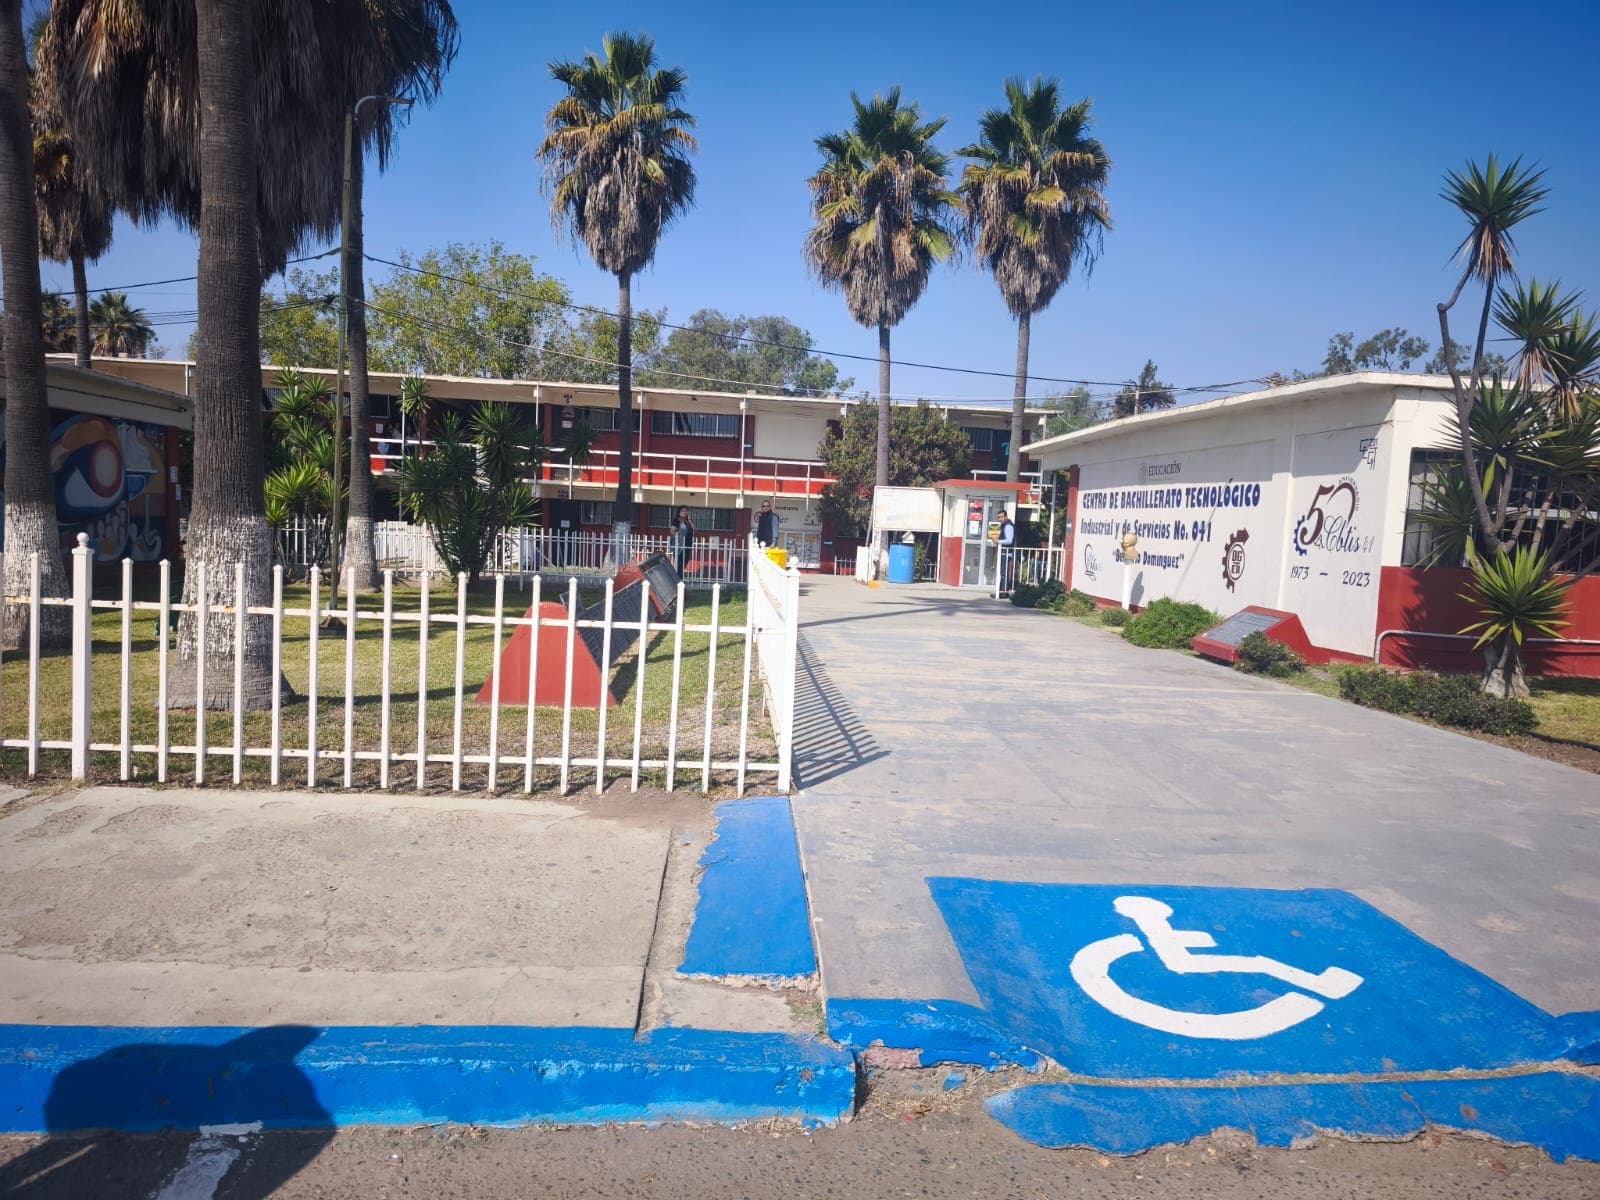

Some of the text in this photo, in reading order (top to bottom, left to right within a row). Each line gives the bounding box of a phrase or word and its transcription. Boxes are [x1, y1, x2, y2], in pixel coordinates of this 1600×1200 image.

[1148, 460, 1182, 476] EDUCACIÓN
[1082, 478, 1261, 510] CENTRO DE BACHILLERATO TECNOLÓGICO
[1080, 518, 1212, 542] Industrial y de Servicios No. 041
[1290, 566, 1310, 580] 1973
[1342, 570, 1371, 588] 2023
